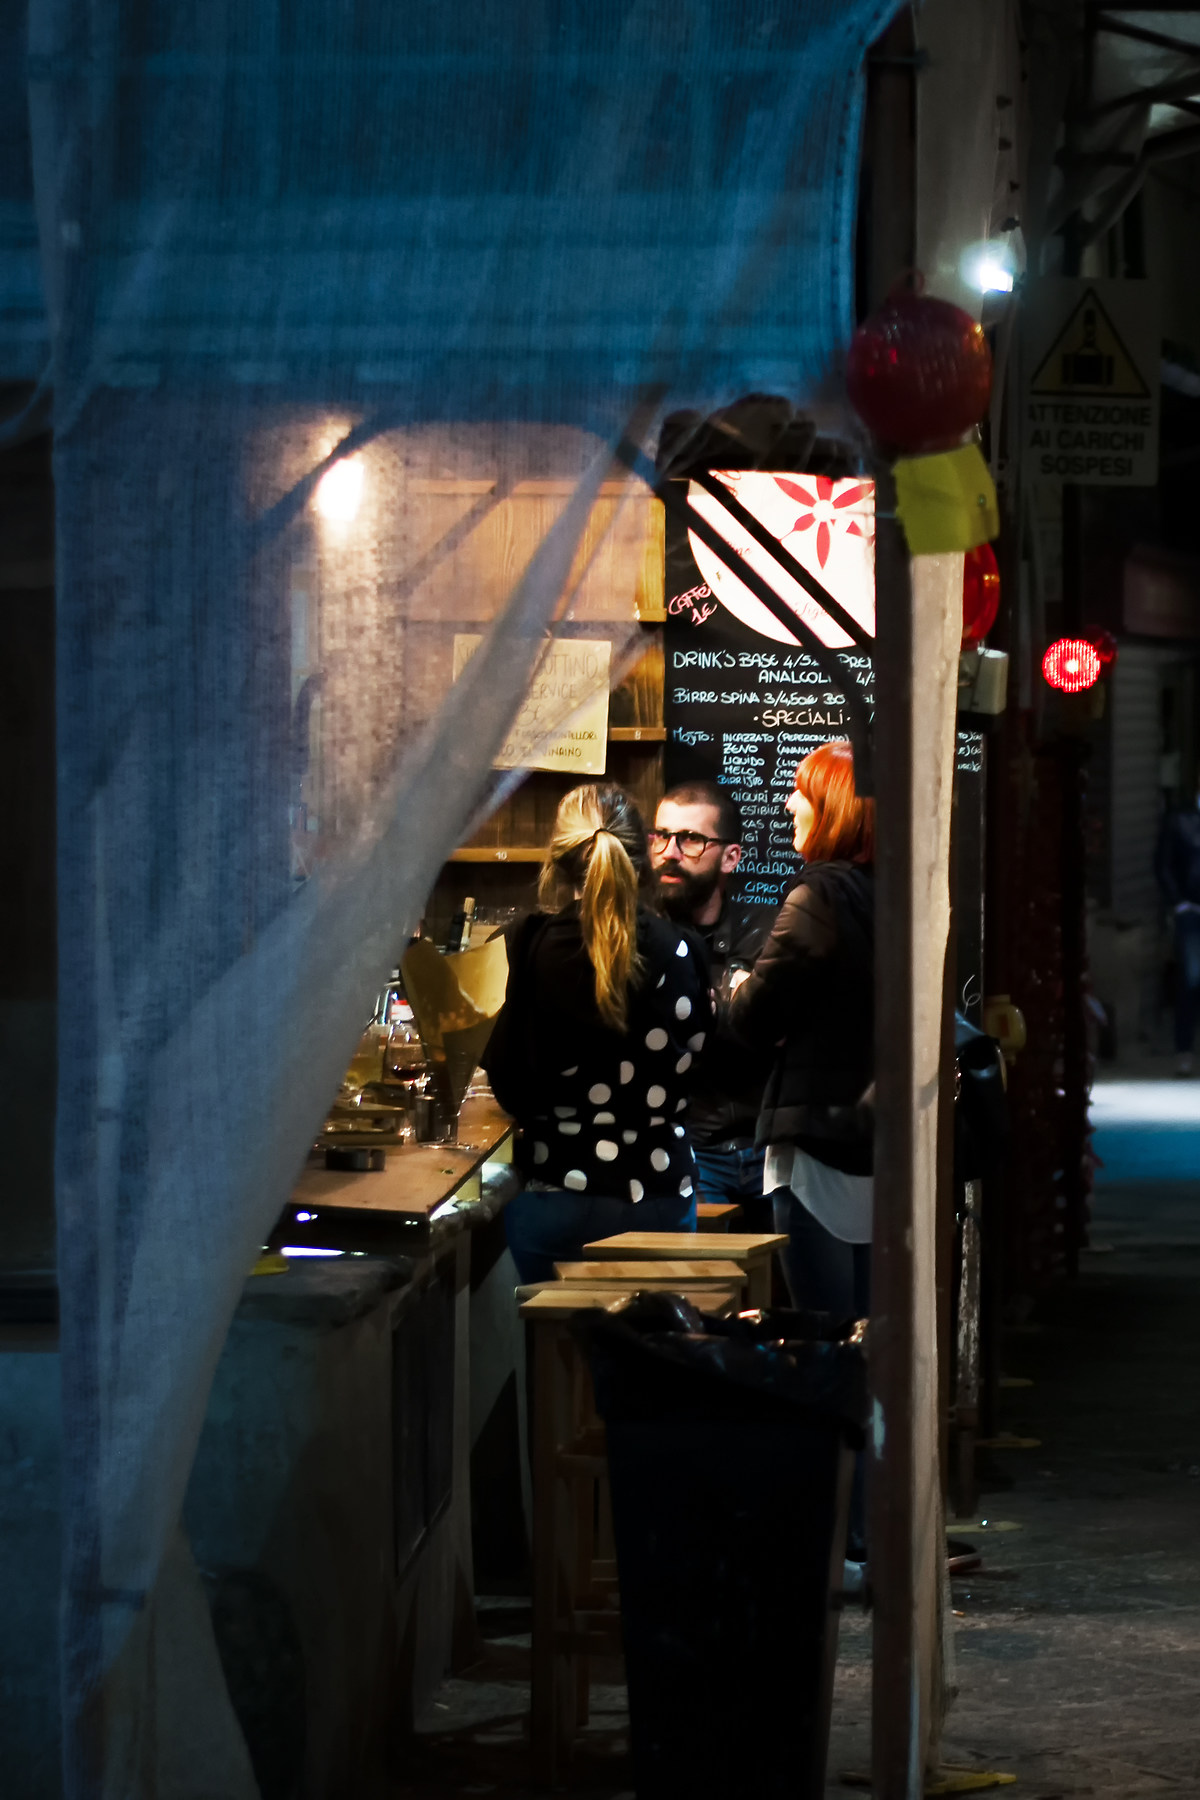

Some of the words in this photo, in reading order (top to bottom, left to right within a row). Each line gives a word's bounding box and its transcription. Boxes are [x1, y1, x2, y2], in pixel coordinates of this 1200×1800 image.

[1030, 429, 1050, 448] AI
[1056, 430, 1145, 450] CARICHI
[1040, 454, 1133, 476] SOSPESI
[738, 653, 779, 668] BASE
[720, 689, 760, 704] SPINA
[723, 743, 759, 754] ZENO
[722, 755, 765, 767] LIQUIDO
[724, 766, 757, 777] MELO
